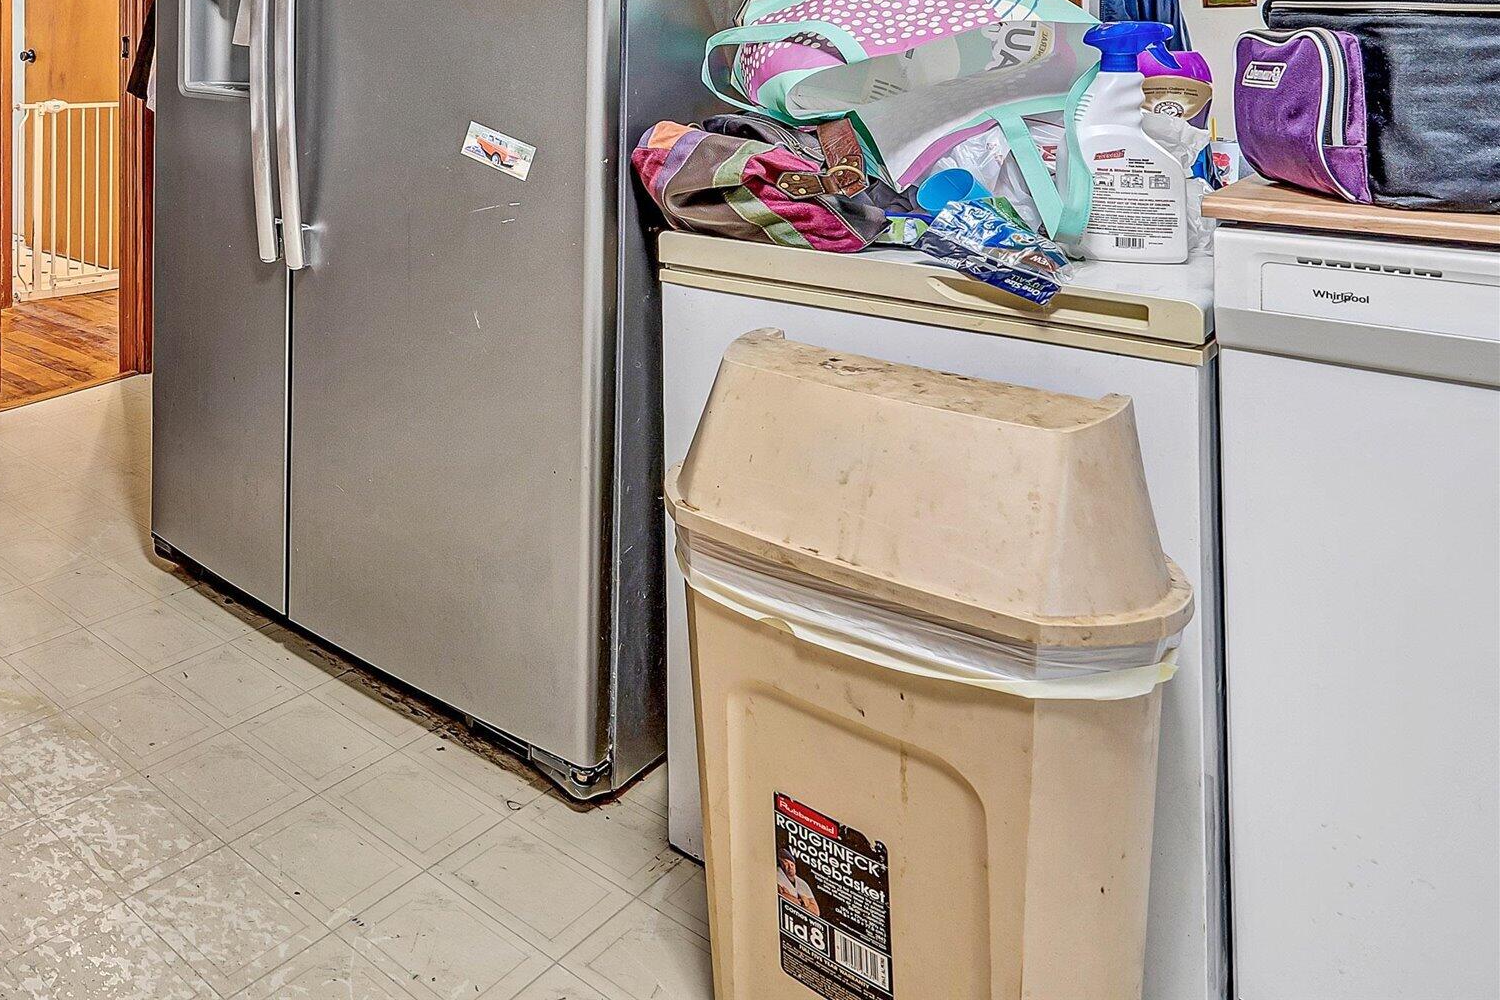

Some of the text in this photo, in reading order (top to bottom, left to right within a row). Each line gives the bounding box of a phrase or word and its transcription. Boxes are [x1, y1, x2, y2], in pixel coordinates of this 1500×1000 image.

[1004, 278, 1040, 296] One Size
[1312, 288, 1370, 305] Whirlpool
[779, 800, 835, 835] Rubbermaid
[776, 813, 880, 878] ROUGHNECK
[788, 832, 852, 875] hooded
[788, 845, 886, 903] wastebasket
[784, 913, 808, 942] lid
[810, 926, 826, 951] 8
